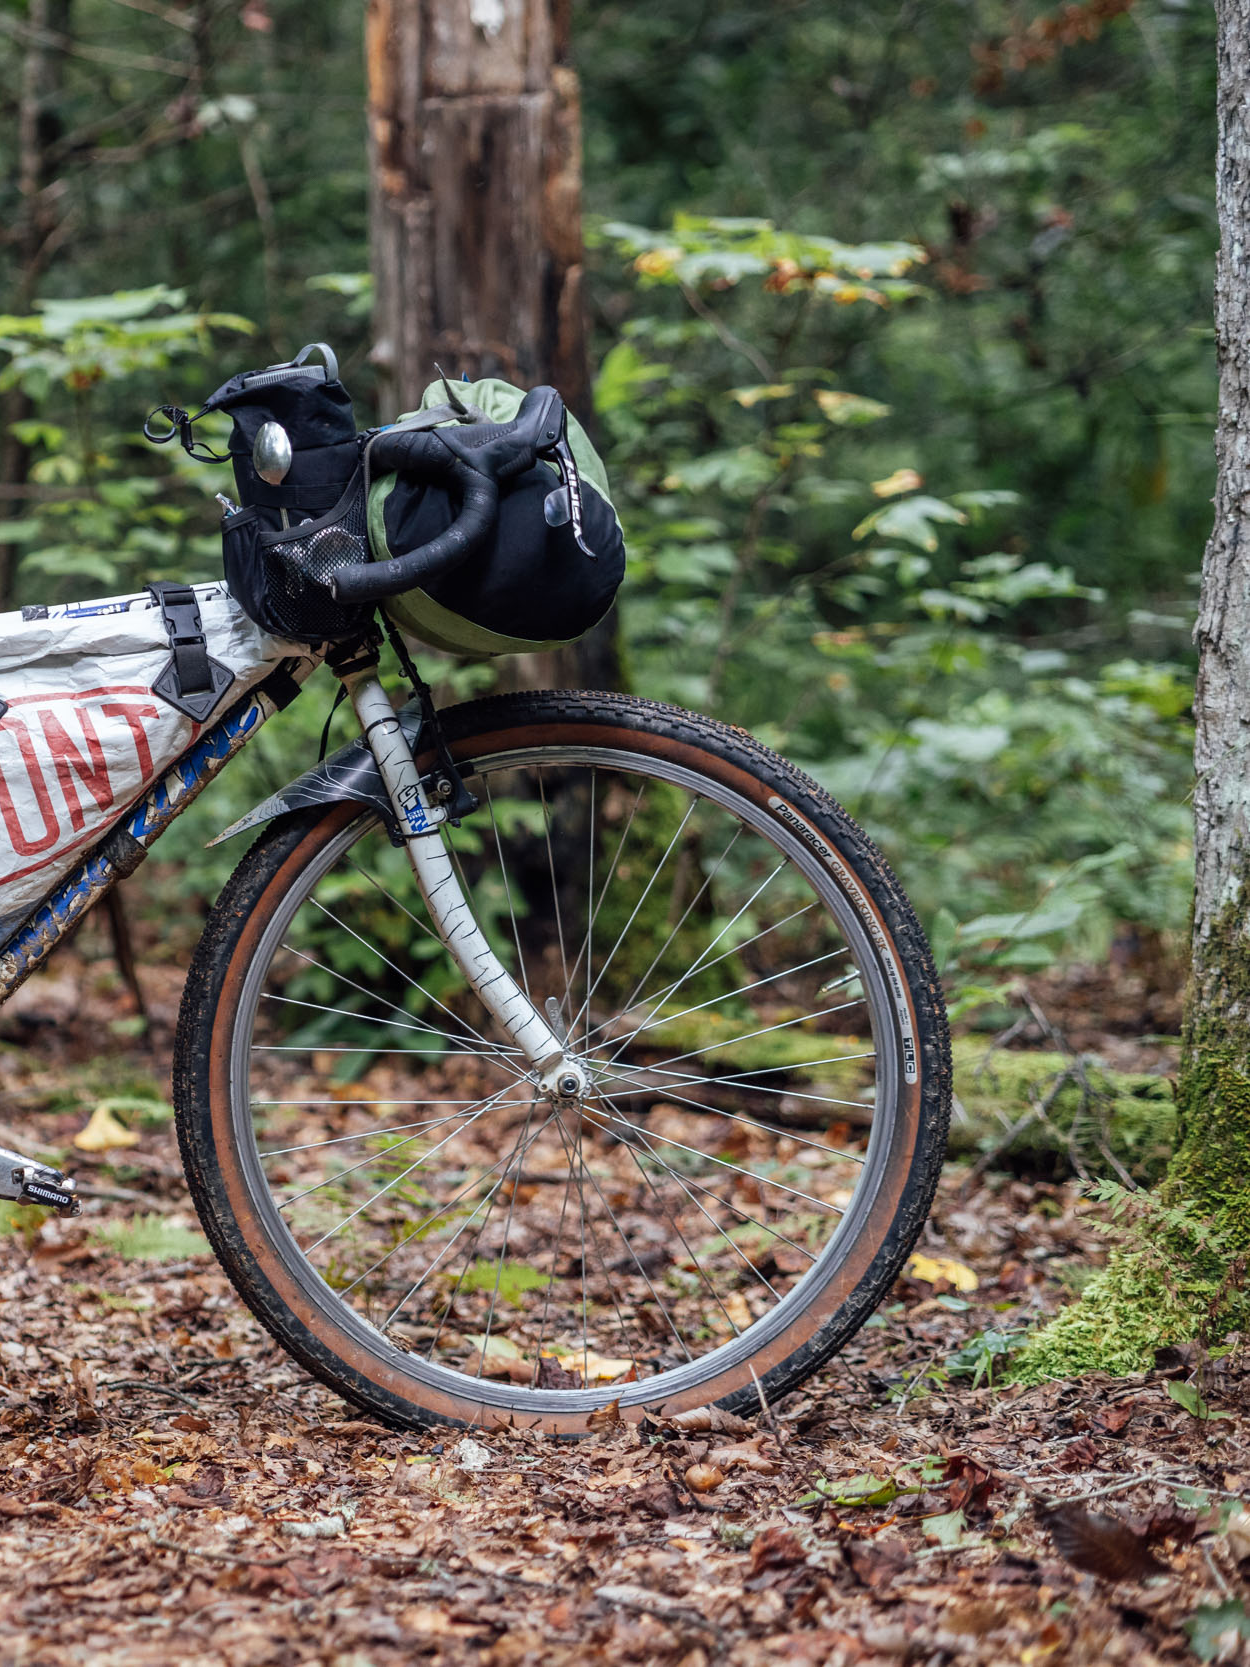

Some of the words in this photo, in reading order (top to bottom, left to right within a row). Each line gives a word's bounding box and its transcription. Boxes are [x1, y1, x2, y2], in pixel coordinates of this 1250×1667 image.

[775, 802, 832, 859] Panaracer
[830, 860, 881, 937] GRAVELKING
[874, 931, 889, 952] SK
[903, 1038, 915, 1073] TLC
[27, 1184, 69, 1204] SHIMANO
